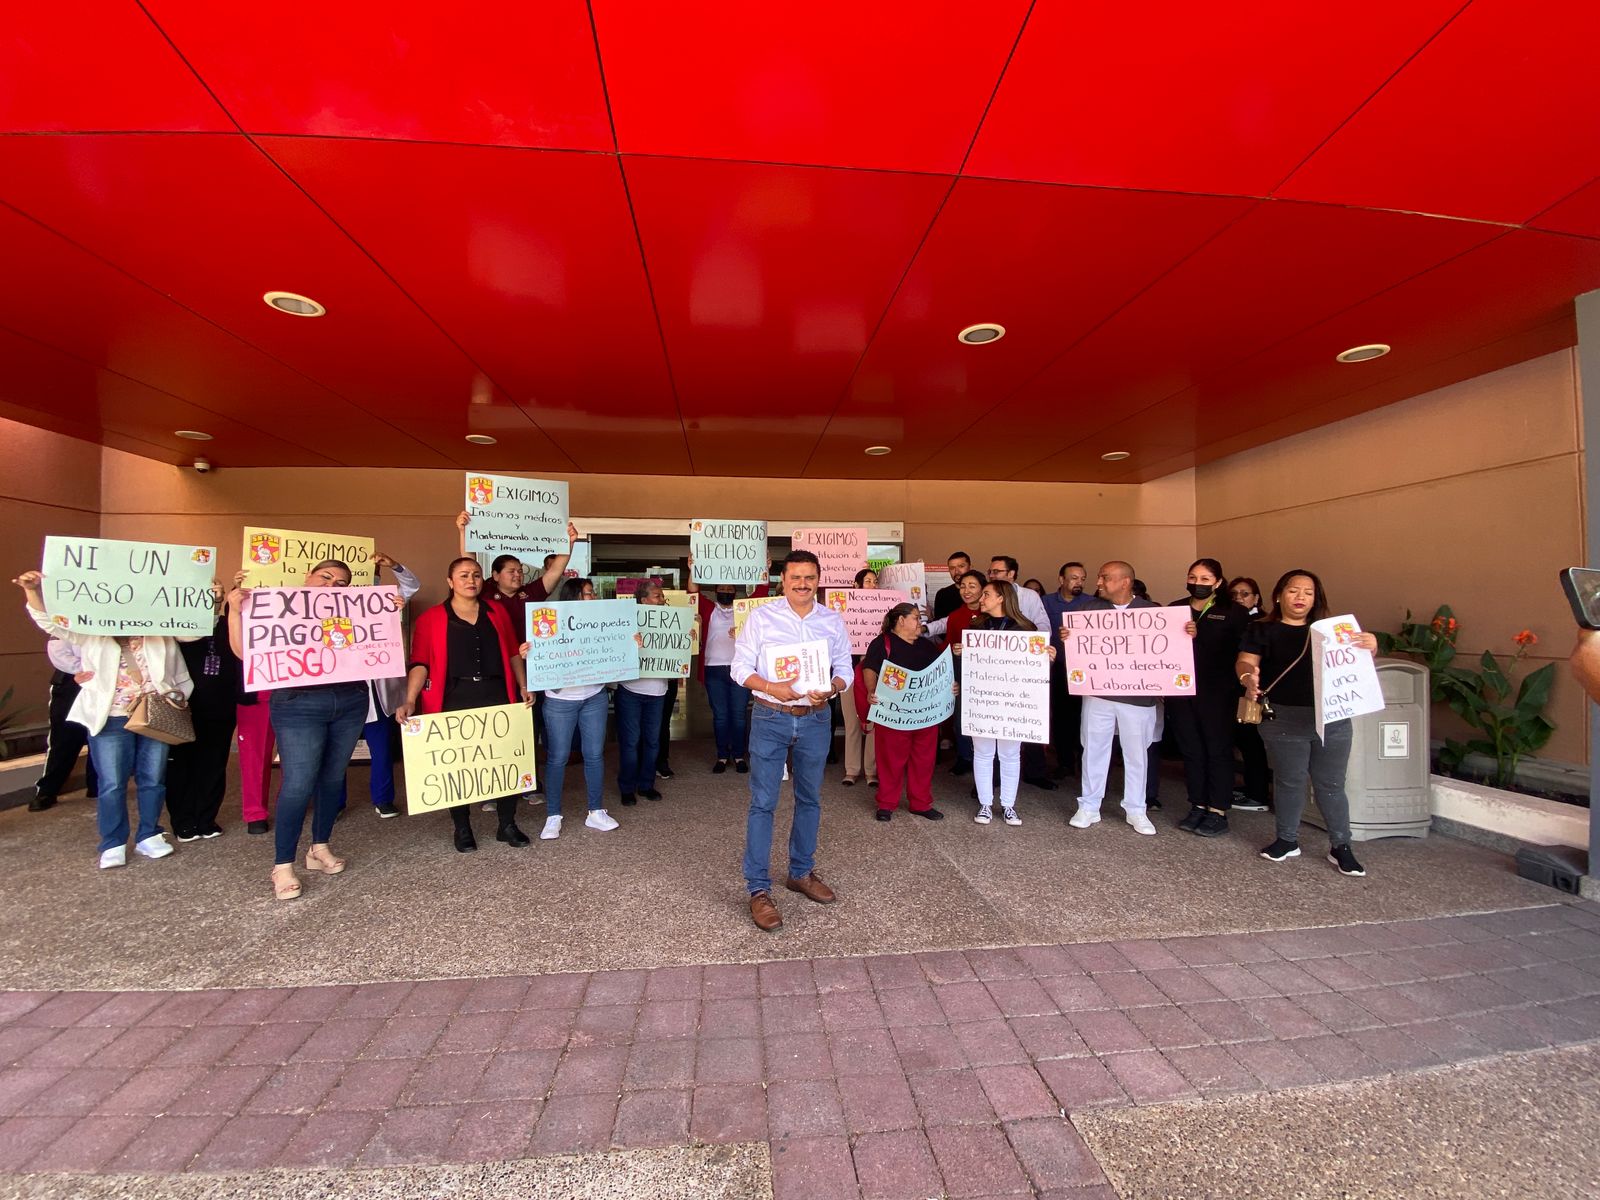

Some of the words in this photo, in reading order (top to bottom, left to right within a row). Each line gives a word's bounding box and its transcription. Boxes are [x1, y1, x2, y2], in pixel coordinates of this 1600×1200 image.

[496, 486, 560, 505] EXIGIMOS
[471, 506, 520, 520] Insumos
[541, 536, 568, 544] equipos
[704, 524, 766, 541] QUEREMOS
[808, 532, 858, 547] EXIGIMOS
[284, 539, 368, 564] EXIGIMOS
[485, 543, 495, 551] de
[696, 543, 756, 560] HECHOS
[64, 544, 99, 570] NI
[129, 549, 170, 576] UN
[852, 551, 862, 559] de
[283, 562, 296, 574] la
[694, 565, 712, 580] NO
[56, 578, 134, 604] PASO
[150, 586, 215, 610] ATRAS
[250, 590, 399, 620] EXIGIMOS
[78, 614, 93, 626] Ni
[98, 618, 116, 627] un
[120, 619, 153, 630] paso
[601, 618, 630, 632] puedes
[637, 610, 680, 630] UERA
[1067, 611, 1166, 630] EXIGIMOS
[249, 624, 323, 650] PAGO
[354, 623, 387, 644] DE
[534, 634, 575, 648] brindar
[580, 636, 591, 644] un
[594, 633, 626, 644] servicio
[642, 632, 691, 650] ORIDADES
[966, 632, 1028, 652] EXIGIMOS
[348, 642, 400, 652] CONCEPTO
[1077, 634, 1168, 656] RESPETO
[534, 652, 546, 661] de
[586, 646, 598, 655] sin
[602, 646, 614, 654] los
[970, 653, 1042, 668] Medicamentos
[246, 647, 336, 685] RIESGO
[364, 650, 390, 666] 30
[534, 661, 574, 672] insumos
[1088, 662, 1097, 671] a
[1106, 658, 1124, 670] los
[1130, 660, 1182, 671] derechos
[908, 658, 947, 690] EXIGIMOS
[970, 670, 1008, 682] Material
[1010, 675, 1020, 683] de
[1332, 673, 1358, 688] una
[1090, 677, 1162, 691] Laborales
[968, 697, 1000, 707] equipos
[1020, 690, 1030, 699] de
[1324, 690, 1363, 707] IGNA
[875, 710, 936, 725] Injustificados
[969, 709, 1004, 722] Insumos
[426, 710, 510, 742] APOYO
[969, 722, 986, 734] Pago
[988, 726, 998, 734] de
[426, 744, 502, 766] TOTAL
[514, 740, 526, 757] al
[422, 764, 519, 806] SINDICATO
